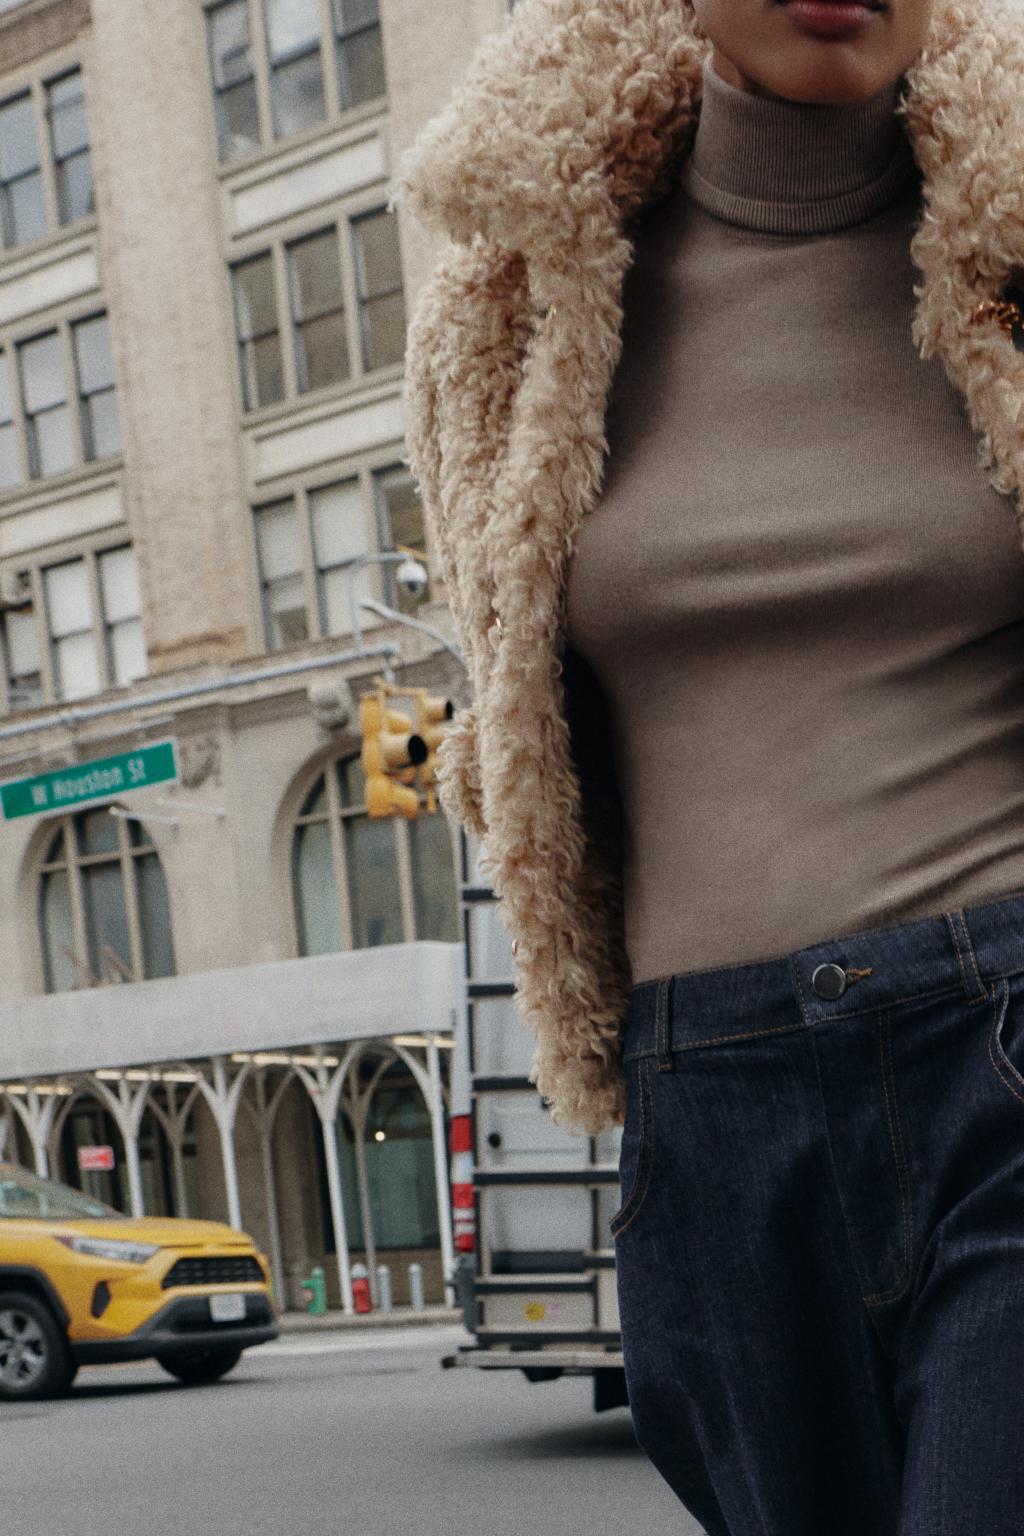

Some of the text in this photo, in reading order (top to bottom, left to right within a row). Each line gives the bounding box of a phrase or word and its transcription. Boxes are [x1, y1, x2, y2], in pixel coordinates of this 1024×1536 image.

[31, 758, 146, 805] W Houston St
